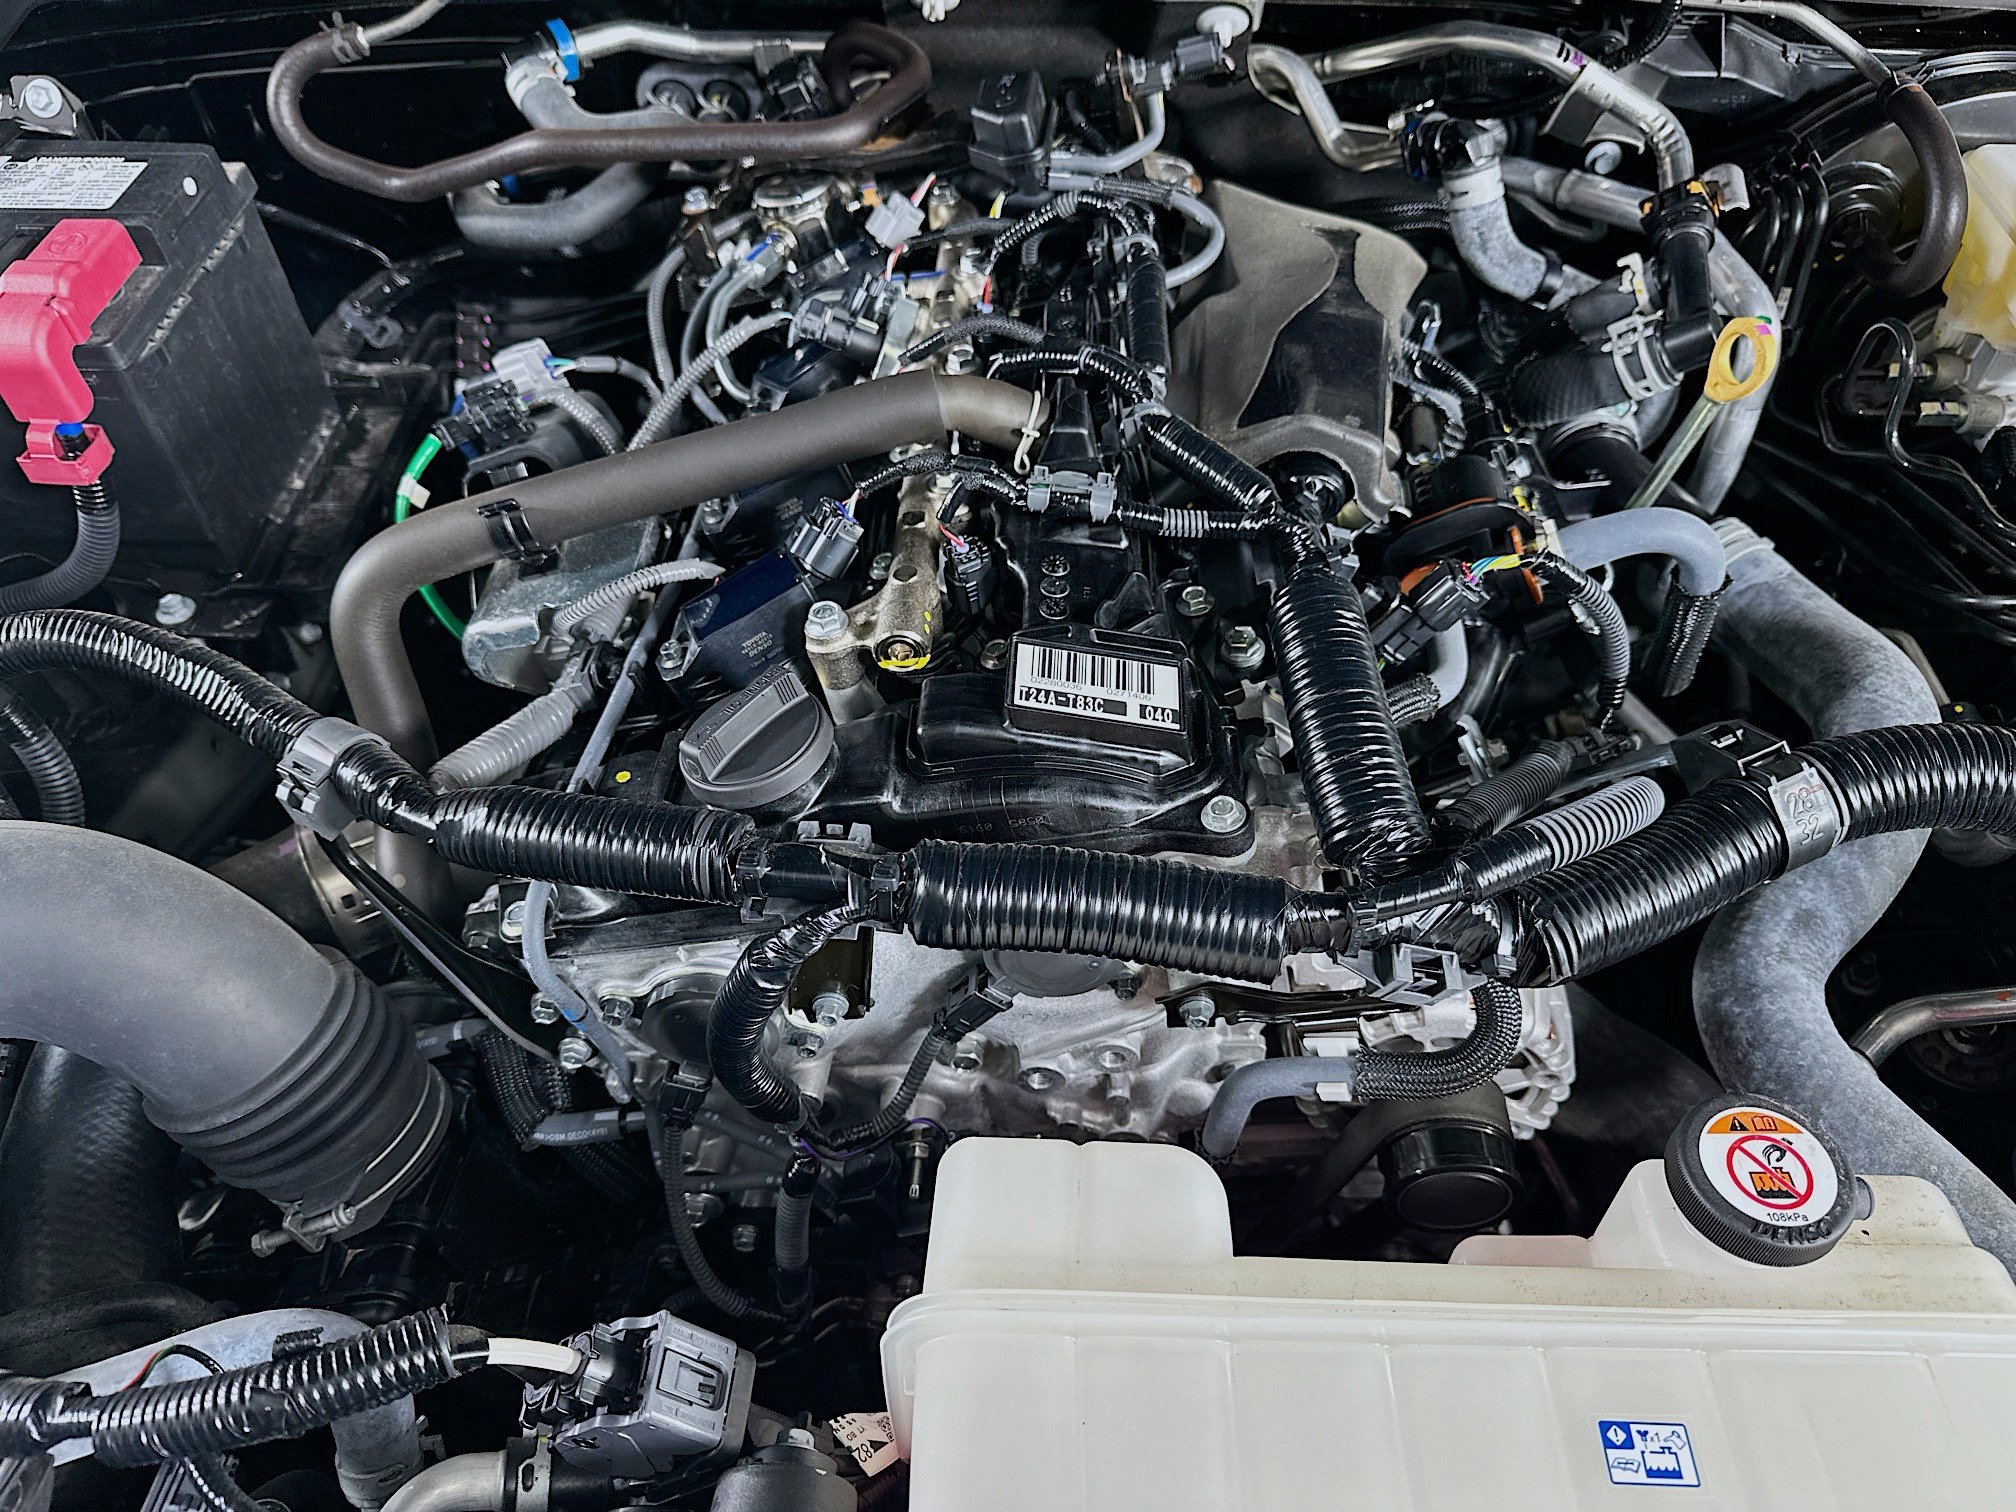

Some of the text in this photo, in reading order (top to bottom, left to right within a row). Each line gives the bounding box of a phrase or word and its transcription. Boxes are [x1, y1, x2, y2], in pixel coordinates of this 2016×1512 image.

[742, 631, 768, 648] TOYOTA
[748, 640, 773, 657] DENSO
[720, 668, 781, 716] ENGINE OIL
[1030, 676, 1152, 701] 02280036 0271406
[1020, 687, 1173, 723] T24A-T83C 040
[1787, 787, 1814, 819] 28
[1796, 814, 1824, 846] 32
[1767, 1212, 1809, 1222] 108kPa
[1751, 1218, 1833, 1244] DENSO
[853, 1443, 873, 1463] 82
